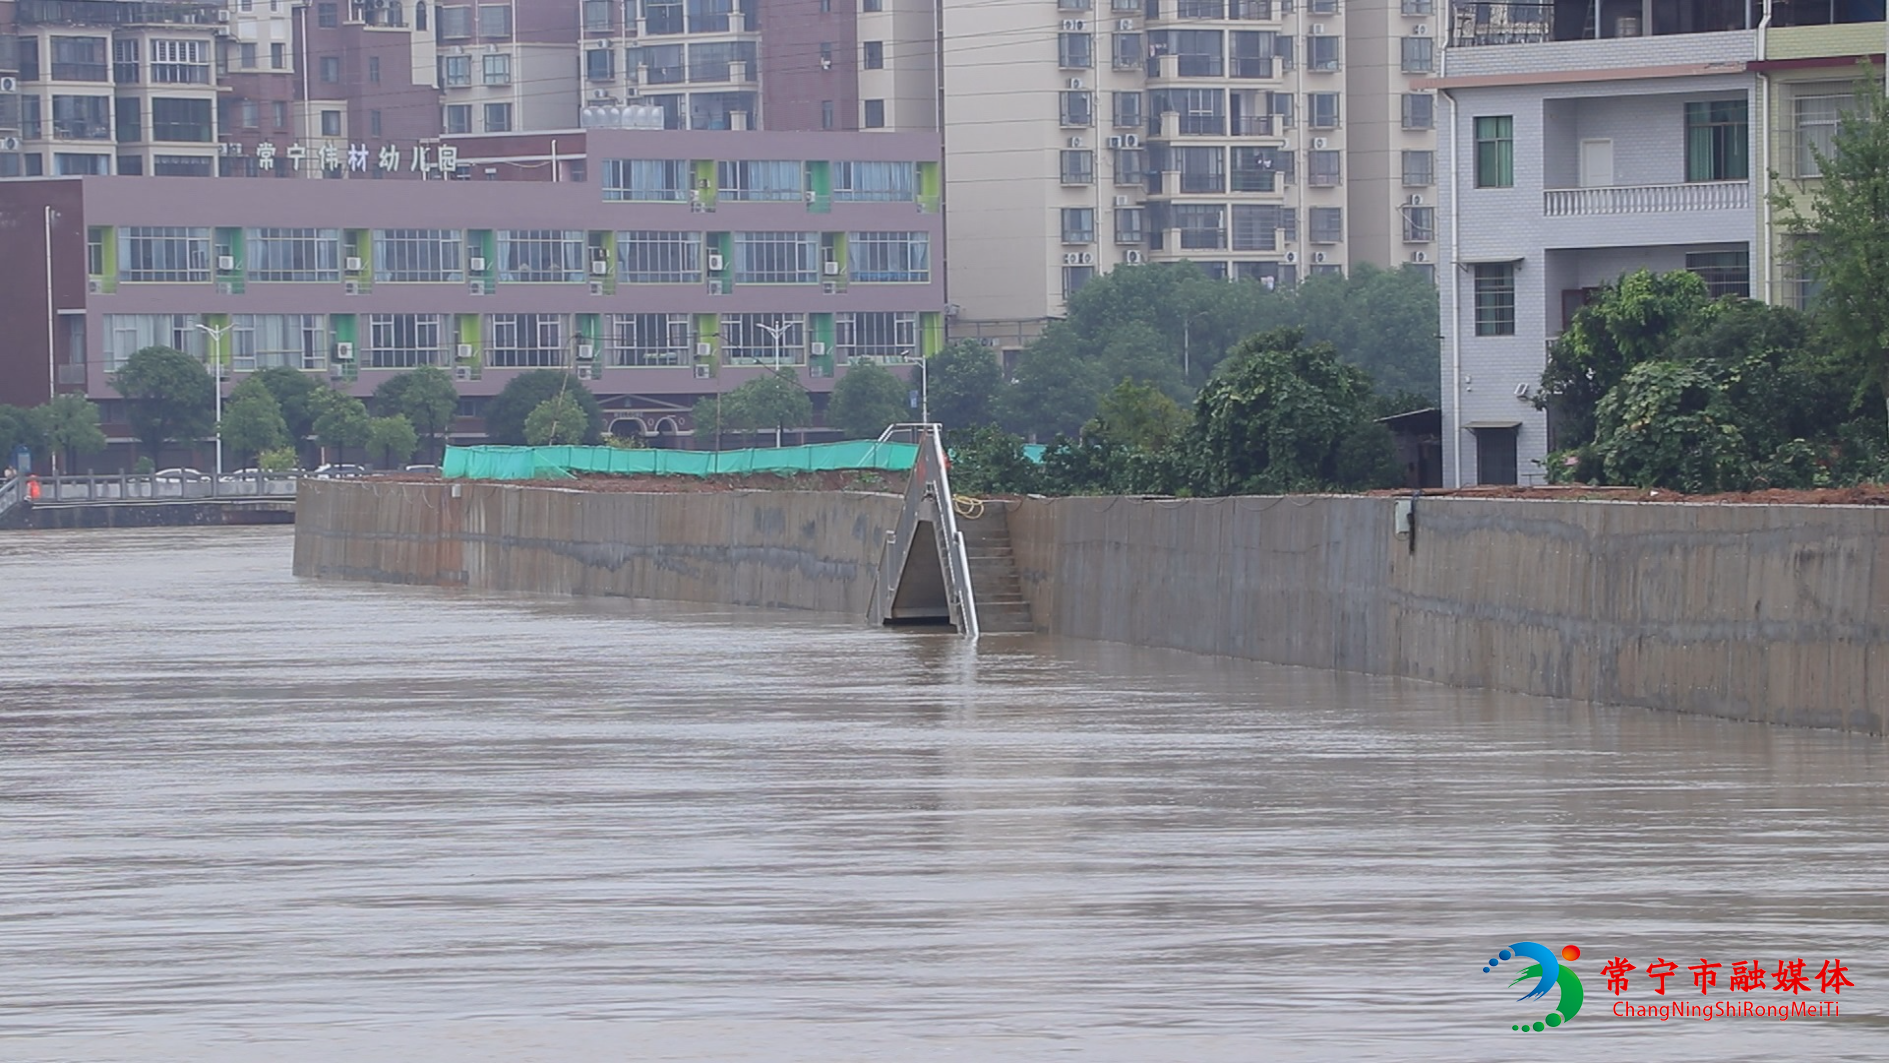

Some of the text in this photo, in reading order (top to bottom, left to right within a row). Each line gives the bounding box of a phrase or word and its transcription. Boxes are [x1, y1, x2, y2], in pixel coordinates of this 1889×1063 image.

[256, 143, 458, 172] 常宁伟材幼儿园
